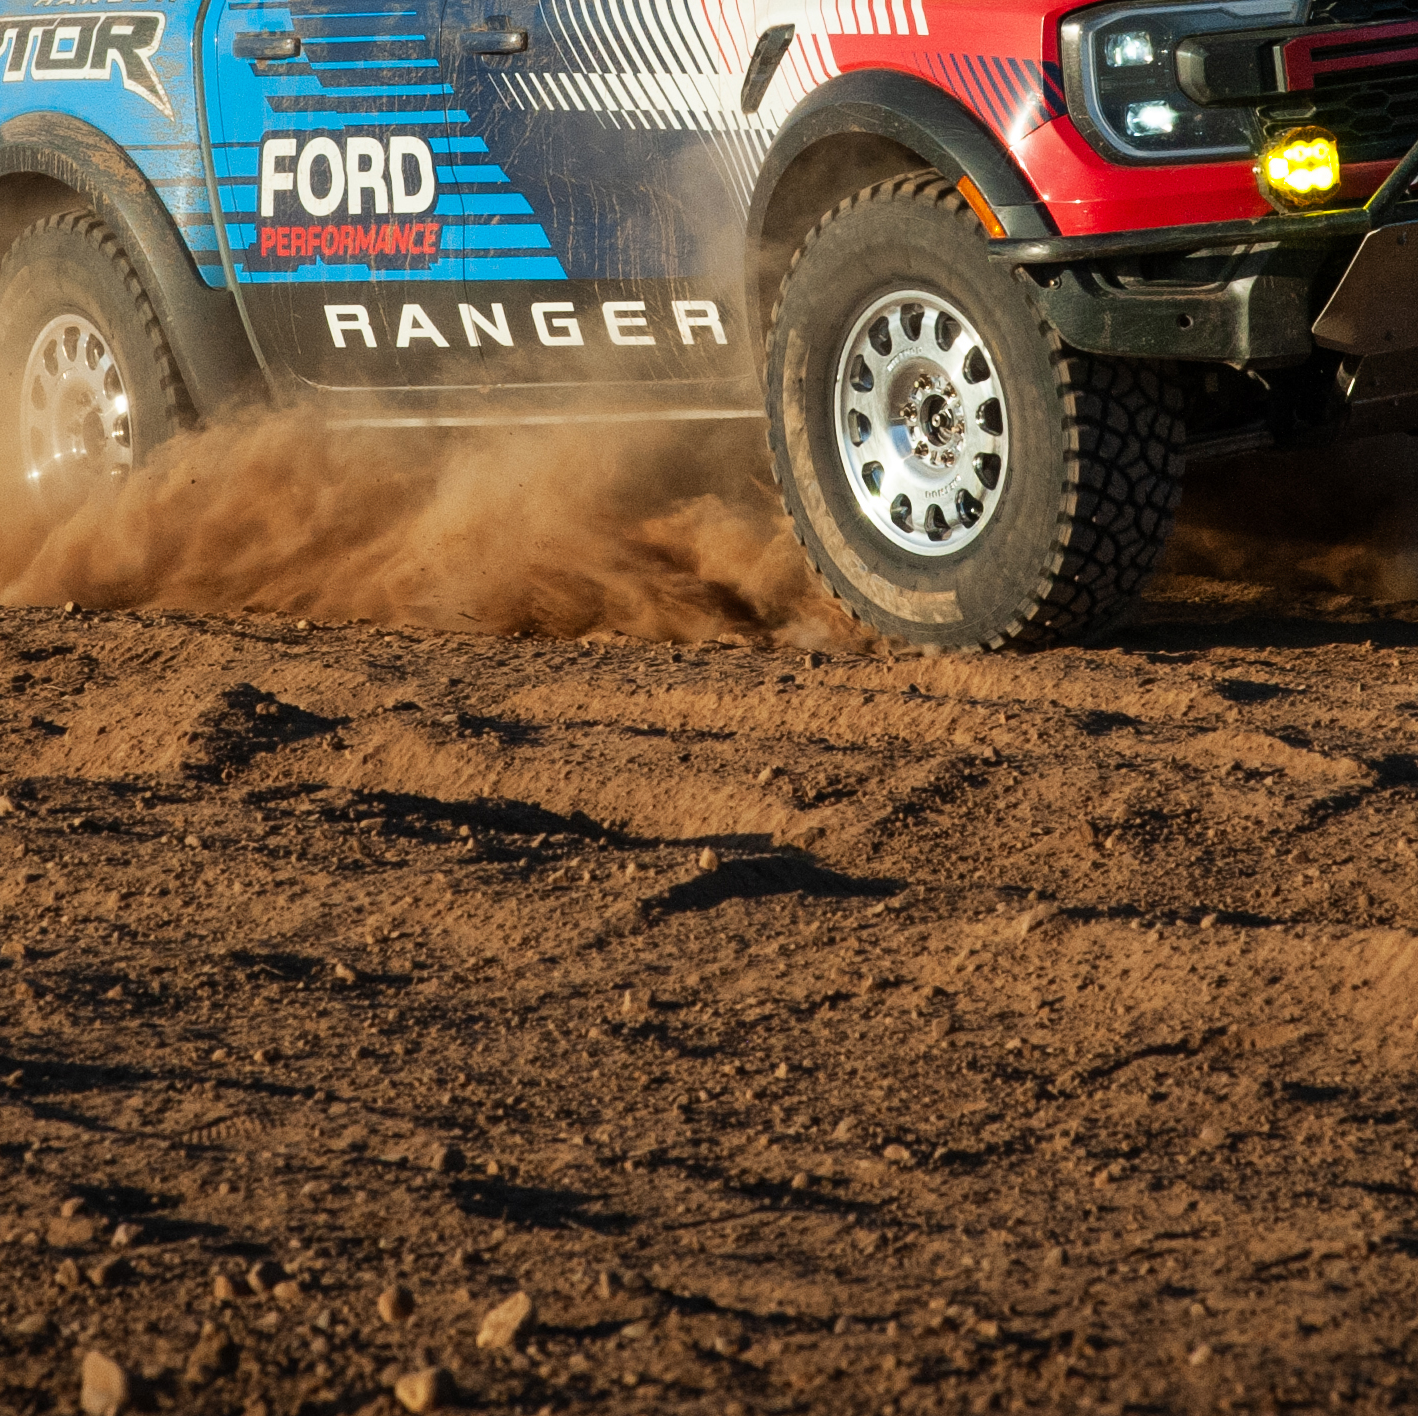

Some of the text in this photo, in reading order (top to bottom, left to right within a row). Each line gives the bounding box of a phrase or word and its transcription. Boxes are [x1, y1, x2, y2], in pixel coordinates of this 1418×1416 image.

[261, 136, 435, 217] FORD
[261, 223, 440, 257] PERFORMANCE
[323, 300, 728, 348] RANGER
